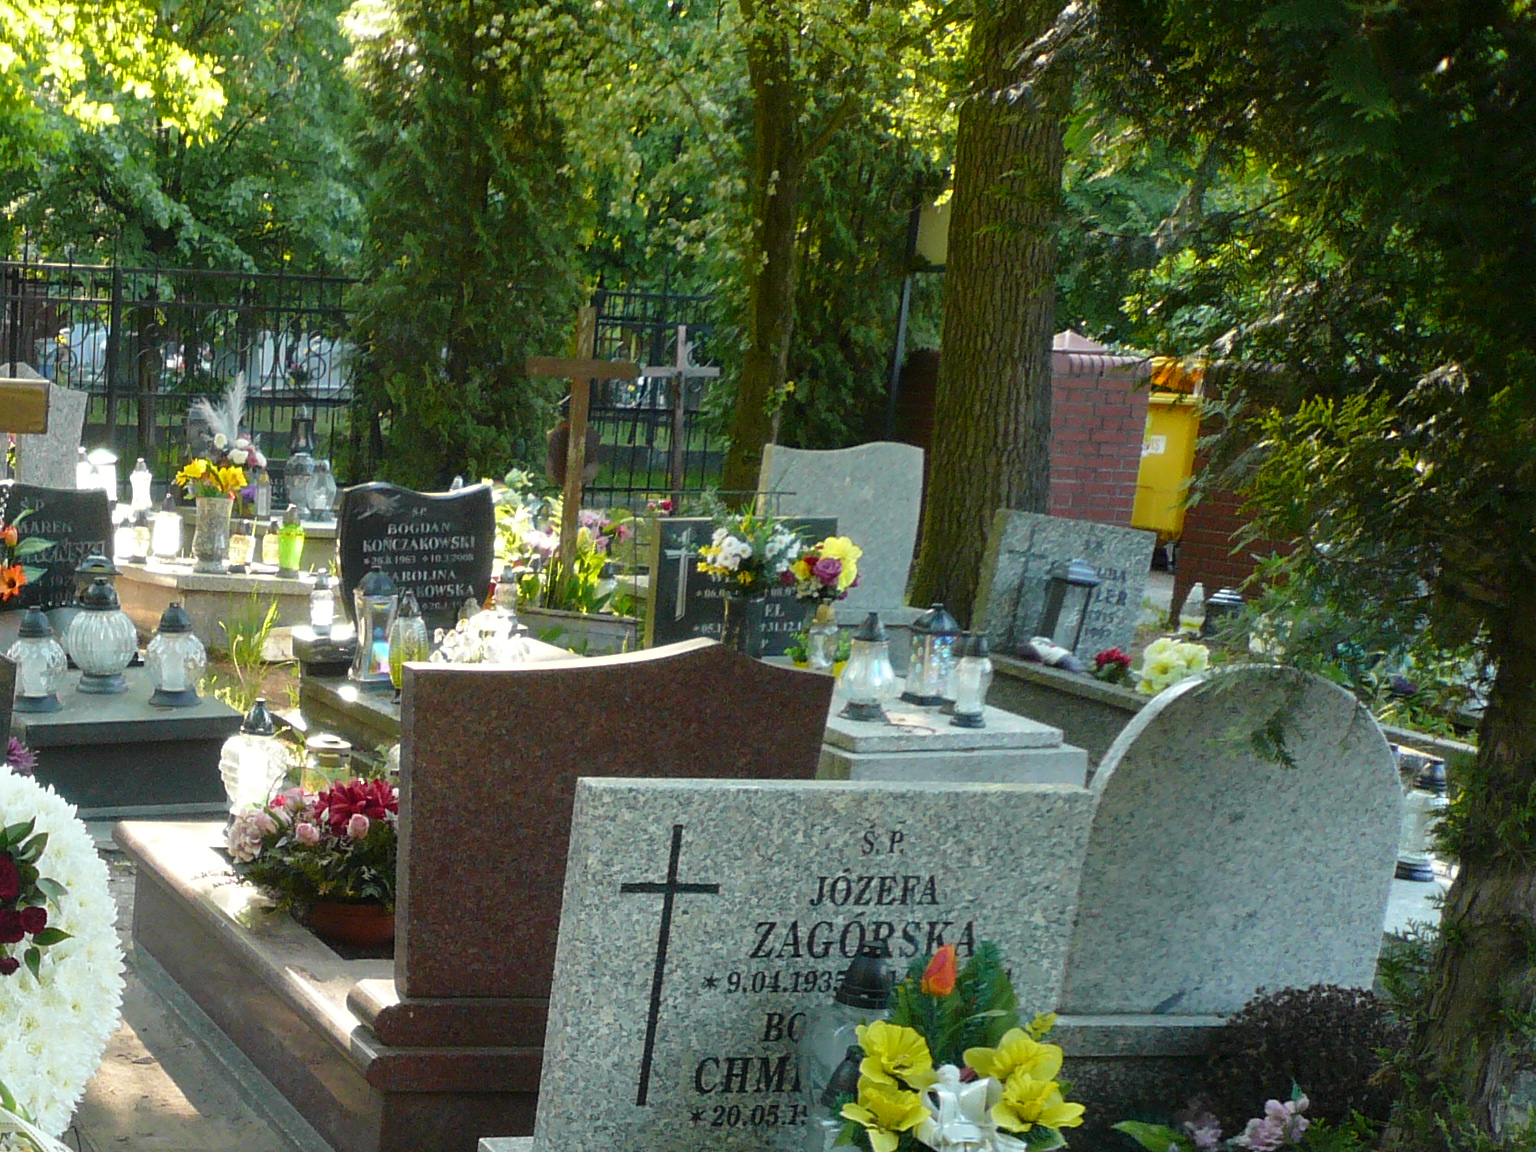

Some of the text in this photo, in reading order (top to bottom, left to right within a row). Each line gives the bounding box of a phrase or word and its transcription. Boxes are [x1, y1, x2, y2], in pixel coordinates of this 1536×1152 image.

[387, 522, 451, 535] BOGDAN
[386, 569, 457, 582] AROLINA
[808, 867, 940, 907] JÓZEFA
[748, 911, 975, 959] ZAGÓRSKA
